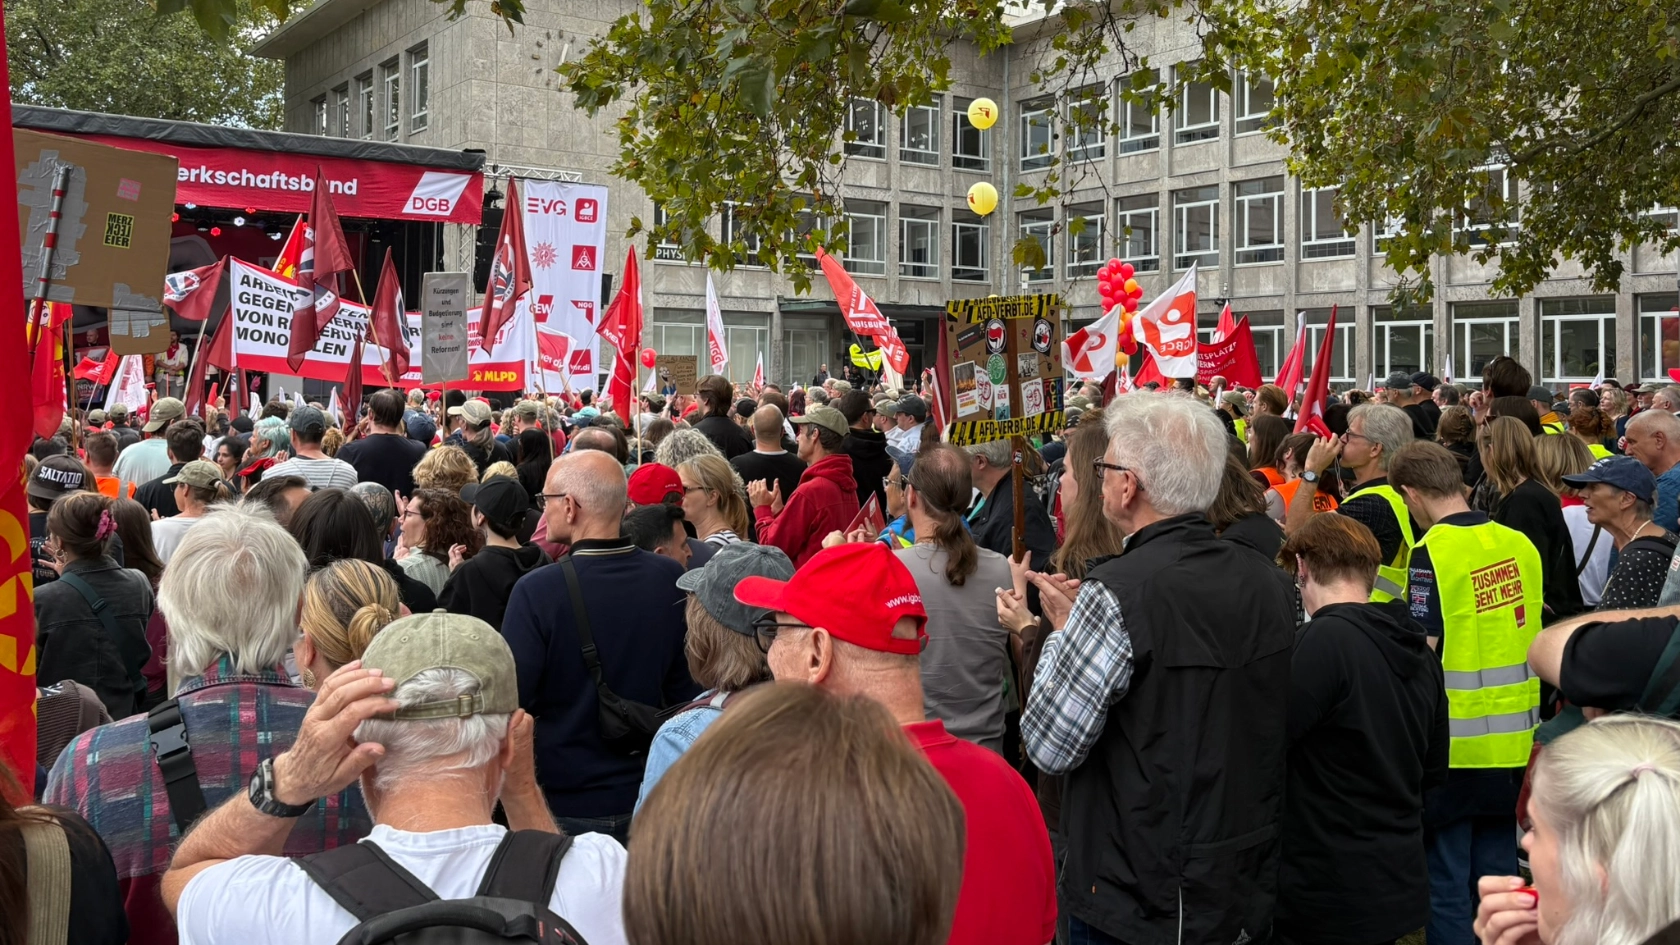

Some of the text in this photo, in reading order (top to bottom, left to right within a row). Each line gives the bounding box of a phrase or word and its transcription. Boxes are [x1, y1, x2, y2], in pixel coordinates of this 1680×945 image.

[178, 165, 358, 195] erkschaftsbnd
[412, 197, 450, 212] DGB
[527, 197, 567, 216] EVG
[108, 213, 133, 226] MERZ
[104, 234, 130, 247] EIER
[430, 309, 463, 318] Budgetierung
[529, 303, 554, 314] GEW
[236, 308, 273, 327] VON
[438, 333, 454, 341] keine
[708, 341, 725, 365] NGG
[1198, 360, 1217, 368] ERN
[484, 371, 518, 382] MLPD
[1044, 381, 1063, 396] FCK
[39, 465, 83, 484] SALTATIO
[1471, 562, 1521, 592] ZUSAMMEN
[1474, 580, 1523, 609] GEHT MEHR
